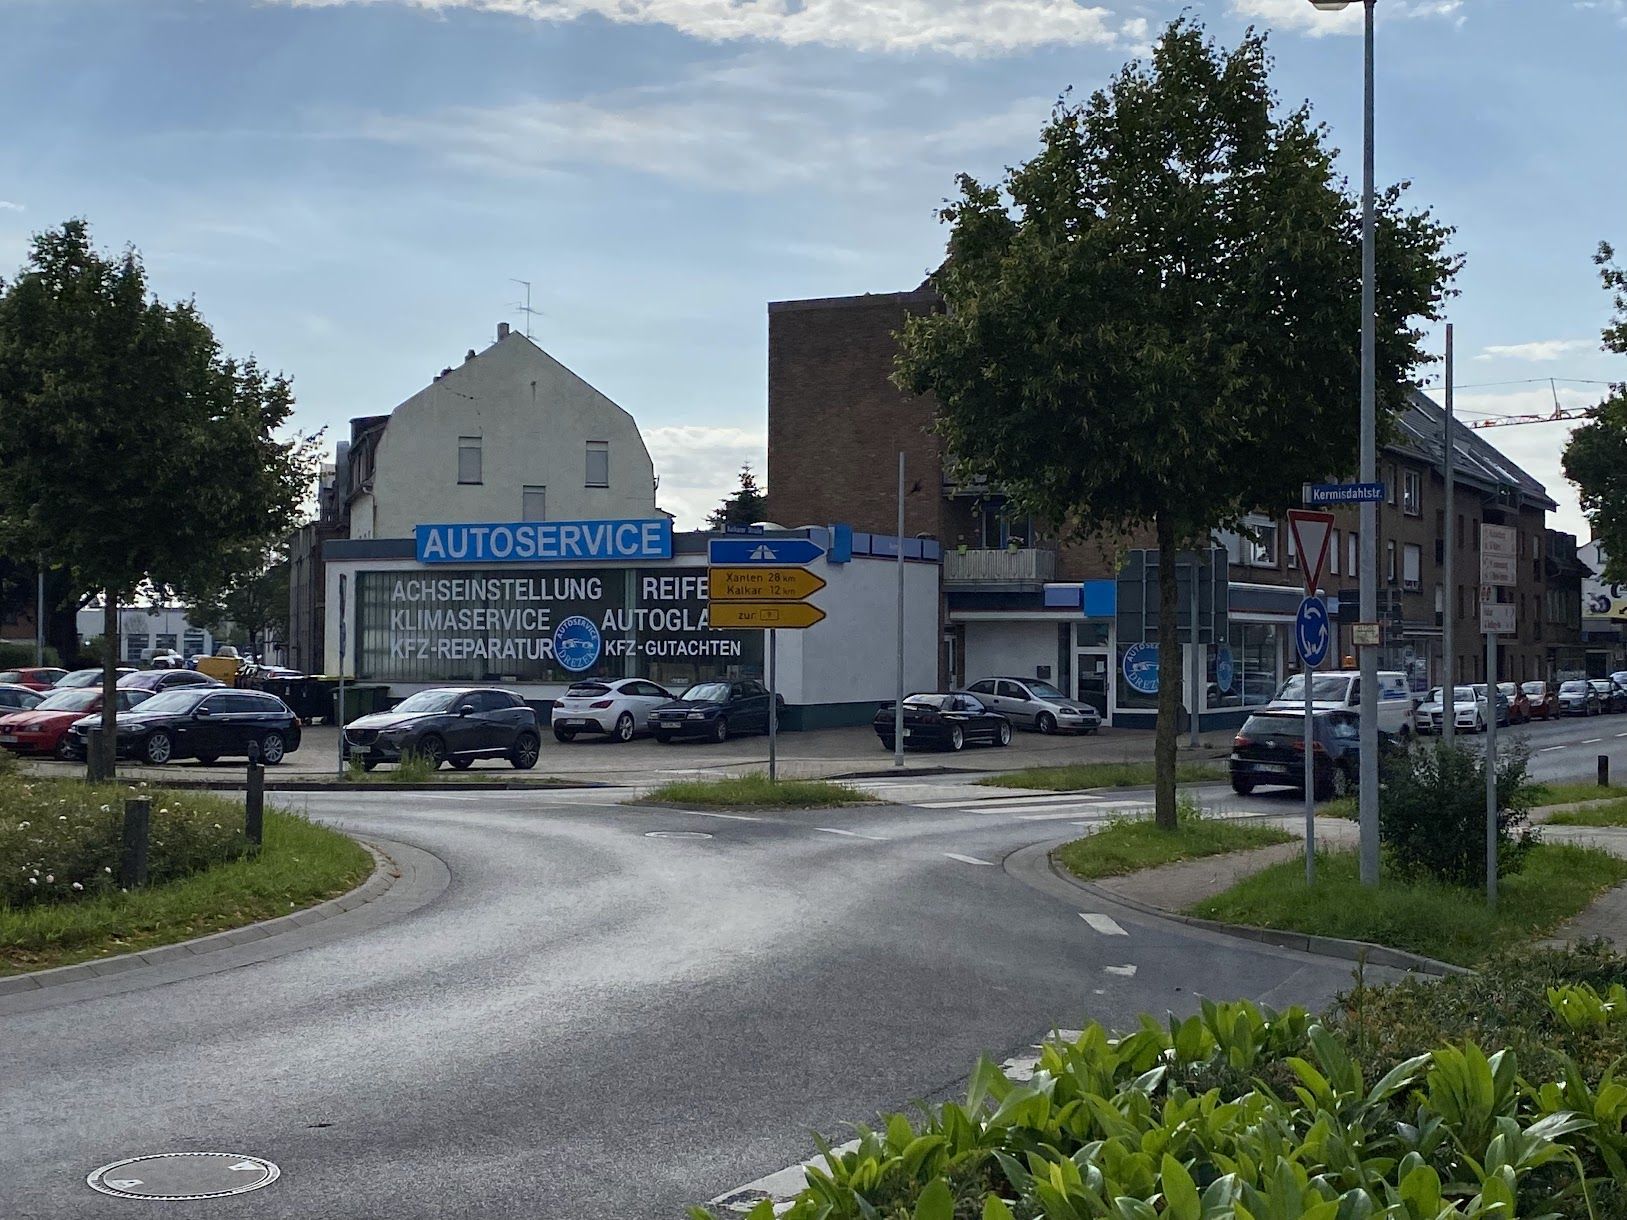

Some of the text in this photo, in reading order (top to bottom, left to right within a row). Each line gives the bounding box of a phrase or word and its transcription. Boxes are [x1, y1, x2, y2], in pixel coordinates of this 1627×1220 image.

[1313, 486, 1383, 501] Kermisdahlstr.
[423, 523, 662, 558] AUTOSERVICE
[726, 573, 763, 582] Xanten
[768, 573, 780, 582] 28
[392, 577, 602, 602] ACHSEINSTELLUNG
[643, 577, 708, 600] REIFE
[727, 586, 762, 595] Kalkar
[770, 586, 780, 595] 12
[390, 608, 551, 631] KLIMASERVICE
[601, 608, 722, 631] AUTOGLA
[738, 612, 756, 620] zur
[557, 619, 598, 640] AUTOSERVICE
[390, 637, 553, 660] KFZ-REPARATUR
[605, 640, 741, 656] KFZ-GUTACHTEN
[559, 649, 596, 667] DREZEK
[1128, 672, 1159, 689] DREZ
